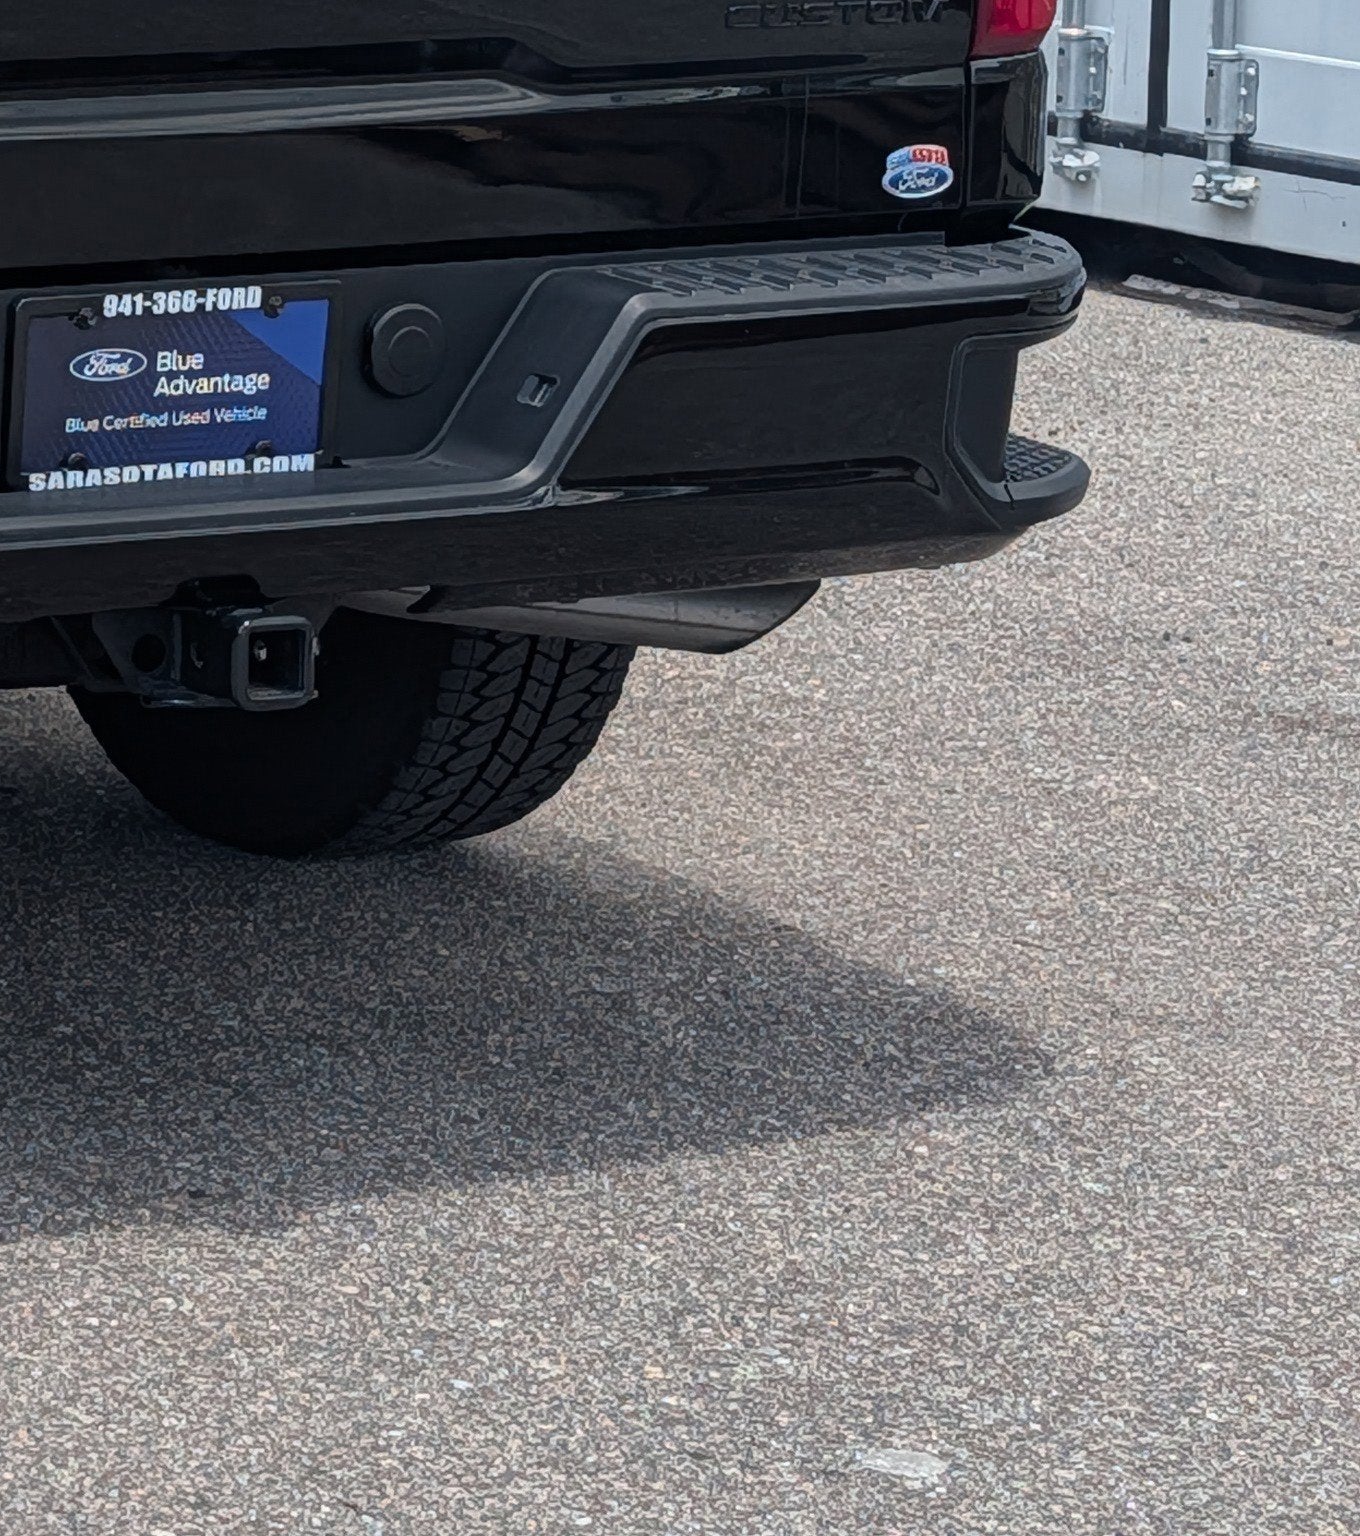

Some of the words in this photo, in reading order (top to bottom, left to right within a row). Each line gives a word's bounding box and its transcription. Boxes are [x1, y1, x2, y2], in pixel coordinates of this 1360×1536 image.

[83, 352, 133, 376] Ford
[156, 349, 204, 372] Blue
[153, 372, 270, 398] Advantage
[65, 418, 100, 433] Blue
[103, 410, 169, 432] Certified
[172, 408, 211, 427] Used
[214, 405, 269, 424] Vehicle
[28, 453, 316, 492] SARASOTAFORD.COM
